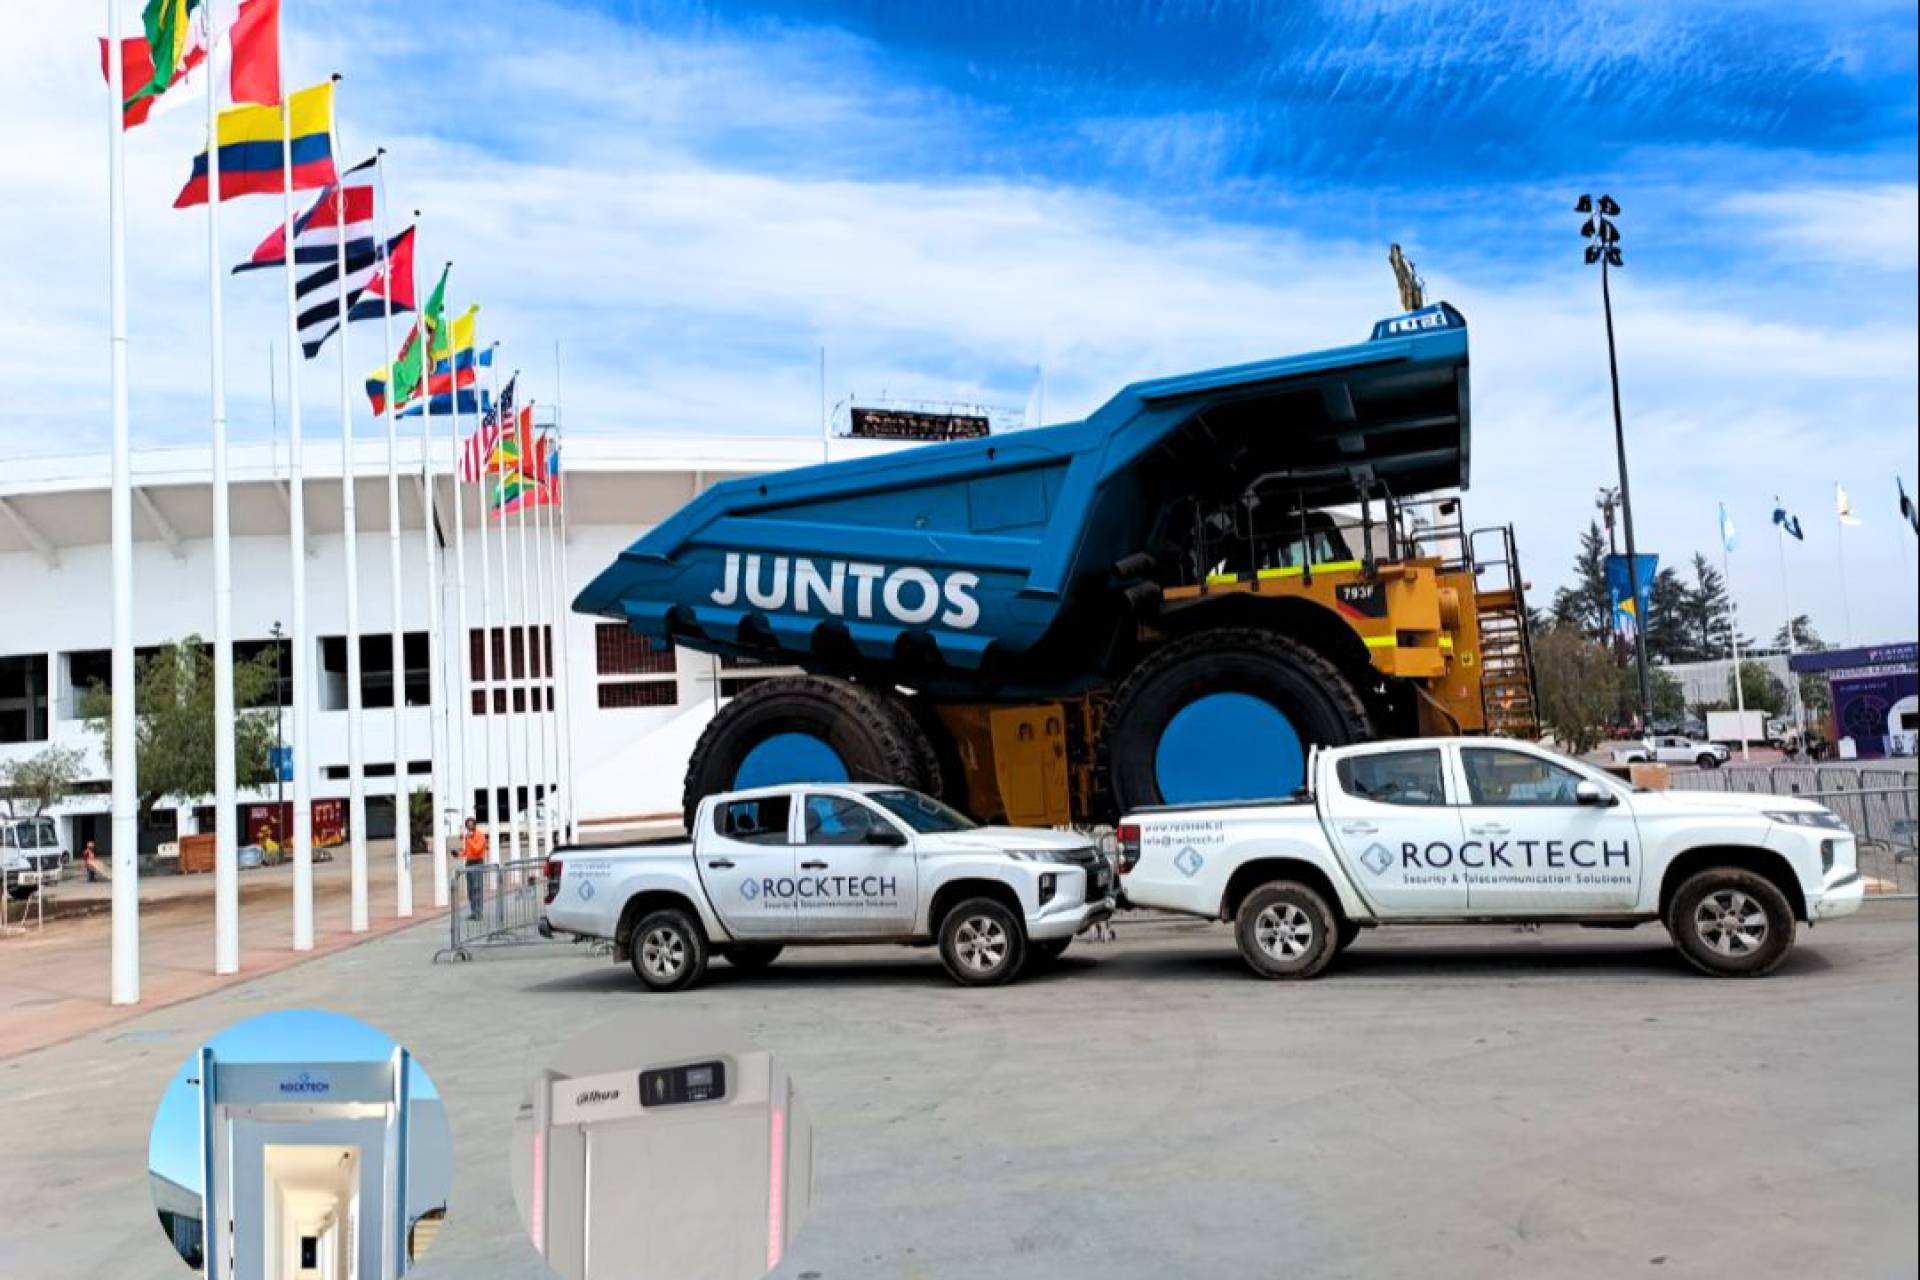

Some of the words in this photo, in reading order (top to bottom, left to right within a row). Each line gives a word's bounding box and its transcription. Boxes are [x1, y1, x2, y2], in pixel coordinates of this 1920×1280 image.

[710, 552, 980, 630] JUNTOS
[1343, 585, 1374, 601] 793F
[1402, 840, 1630, 868] ROCKTECH
[762, 876, 896, 899] ROCKTECH
[1403, 873, 1447, 886] Security
[1451, 873, 1459, 884] &
[1463, 872, 1571, 884] Telecommunication
[1575, 873, 1631, 884] Solutions
